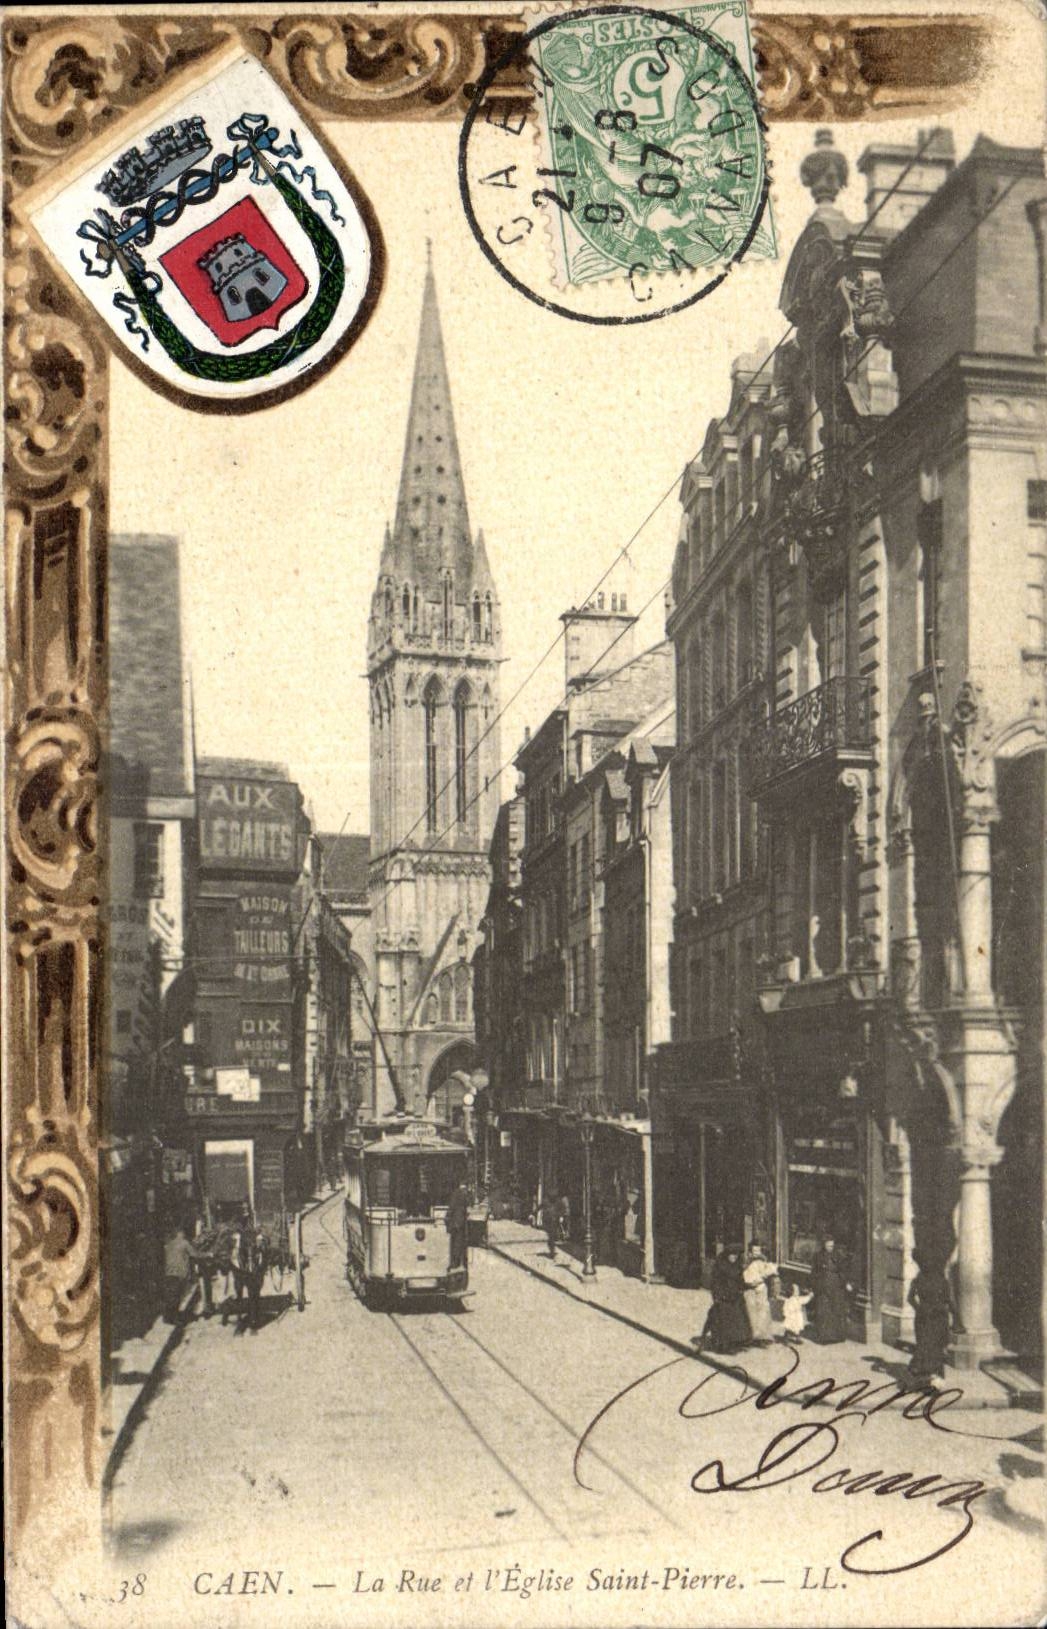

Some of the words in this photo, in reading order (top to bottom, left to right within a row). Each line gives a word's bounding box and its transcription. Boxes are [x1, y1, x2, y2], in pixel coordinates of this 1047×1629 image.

[637, 143, 684, 200] 07
[207, 783, 276, 810] AUX
[240, 895, 289, 914] MAISON
[233, 929, 290, 955] TAILLEURS
[241, 1019, 281, 1035] DIX
[234, 1039, 289, 1052] MAISONS
